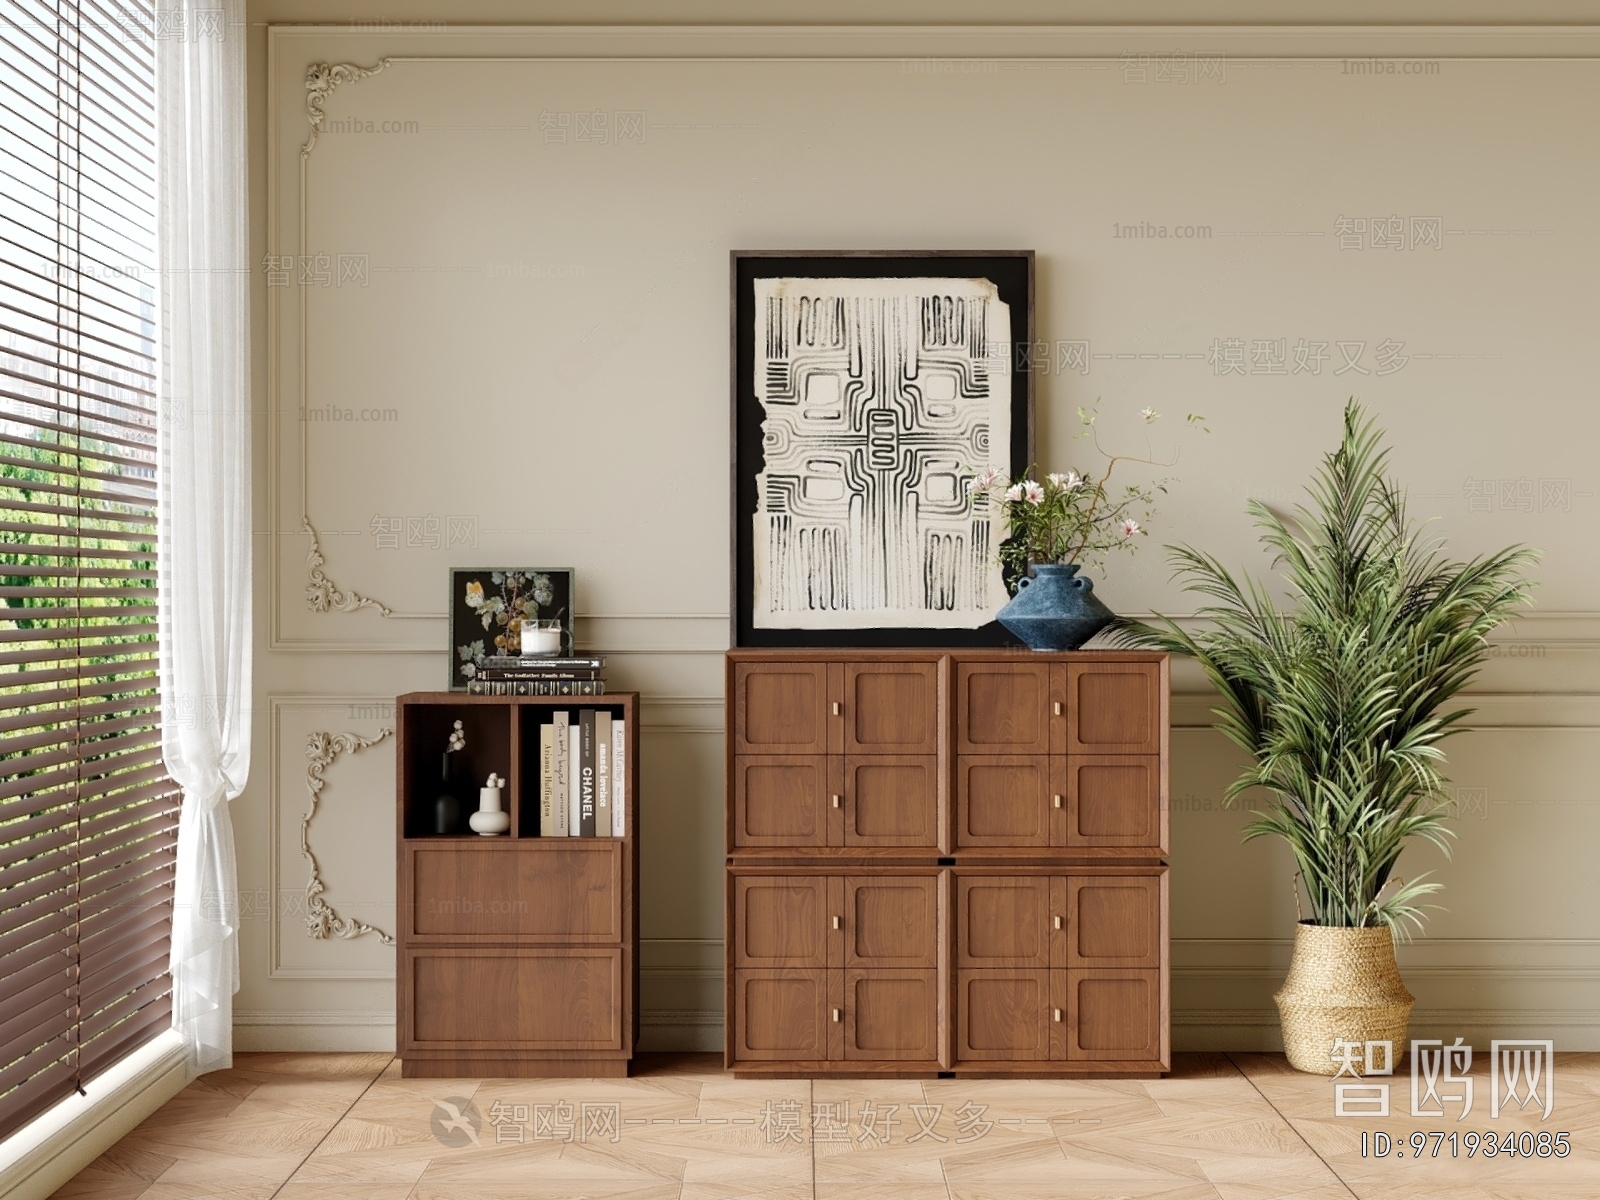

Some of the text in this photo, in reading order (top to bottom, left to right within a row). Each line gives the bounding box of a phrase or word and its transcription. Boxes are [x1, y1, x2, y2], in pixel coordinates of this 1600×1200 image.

[542, 744, 552, 817] Arianna Huffington
[599, 743, 608, 774] amanda
[582, 767, 593, 820] CHANEL
